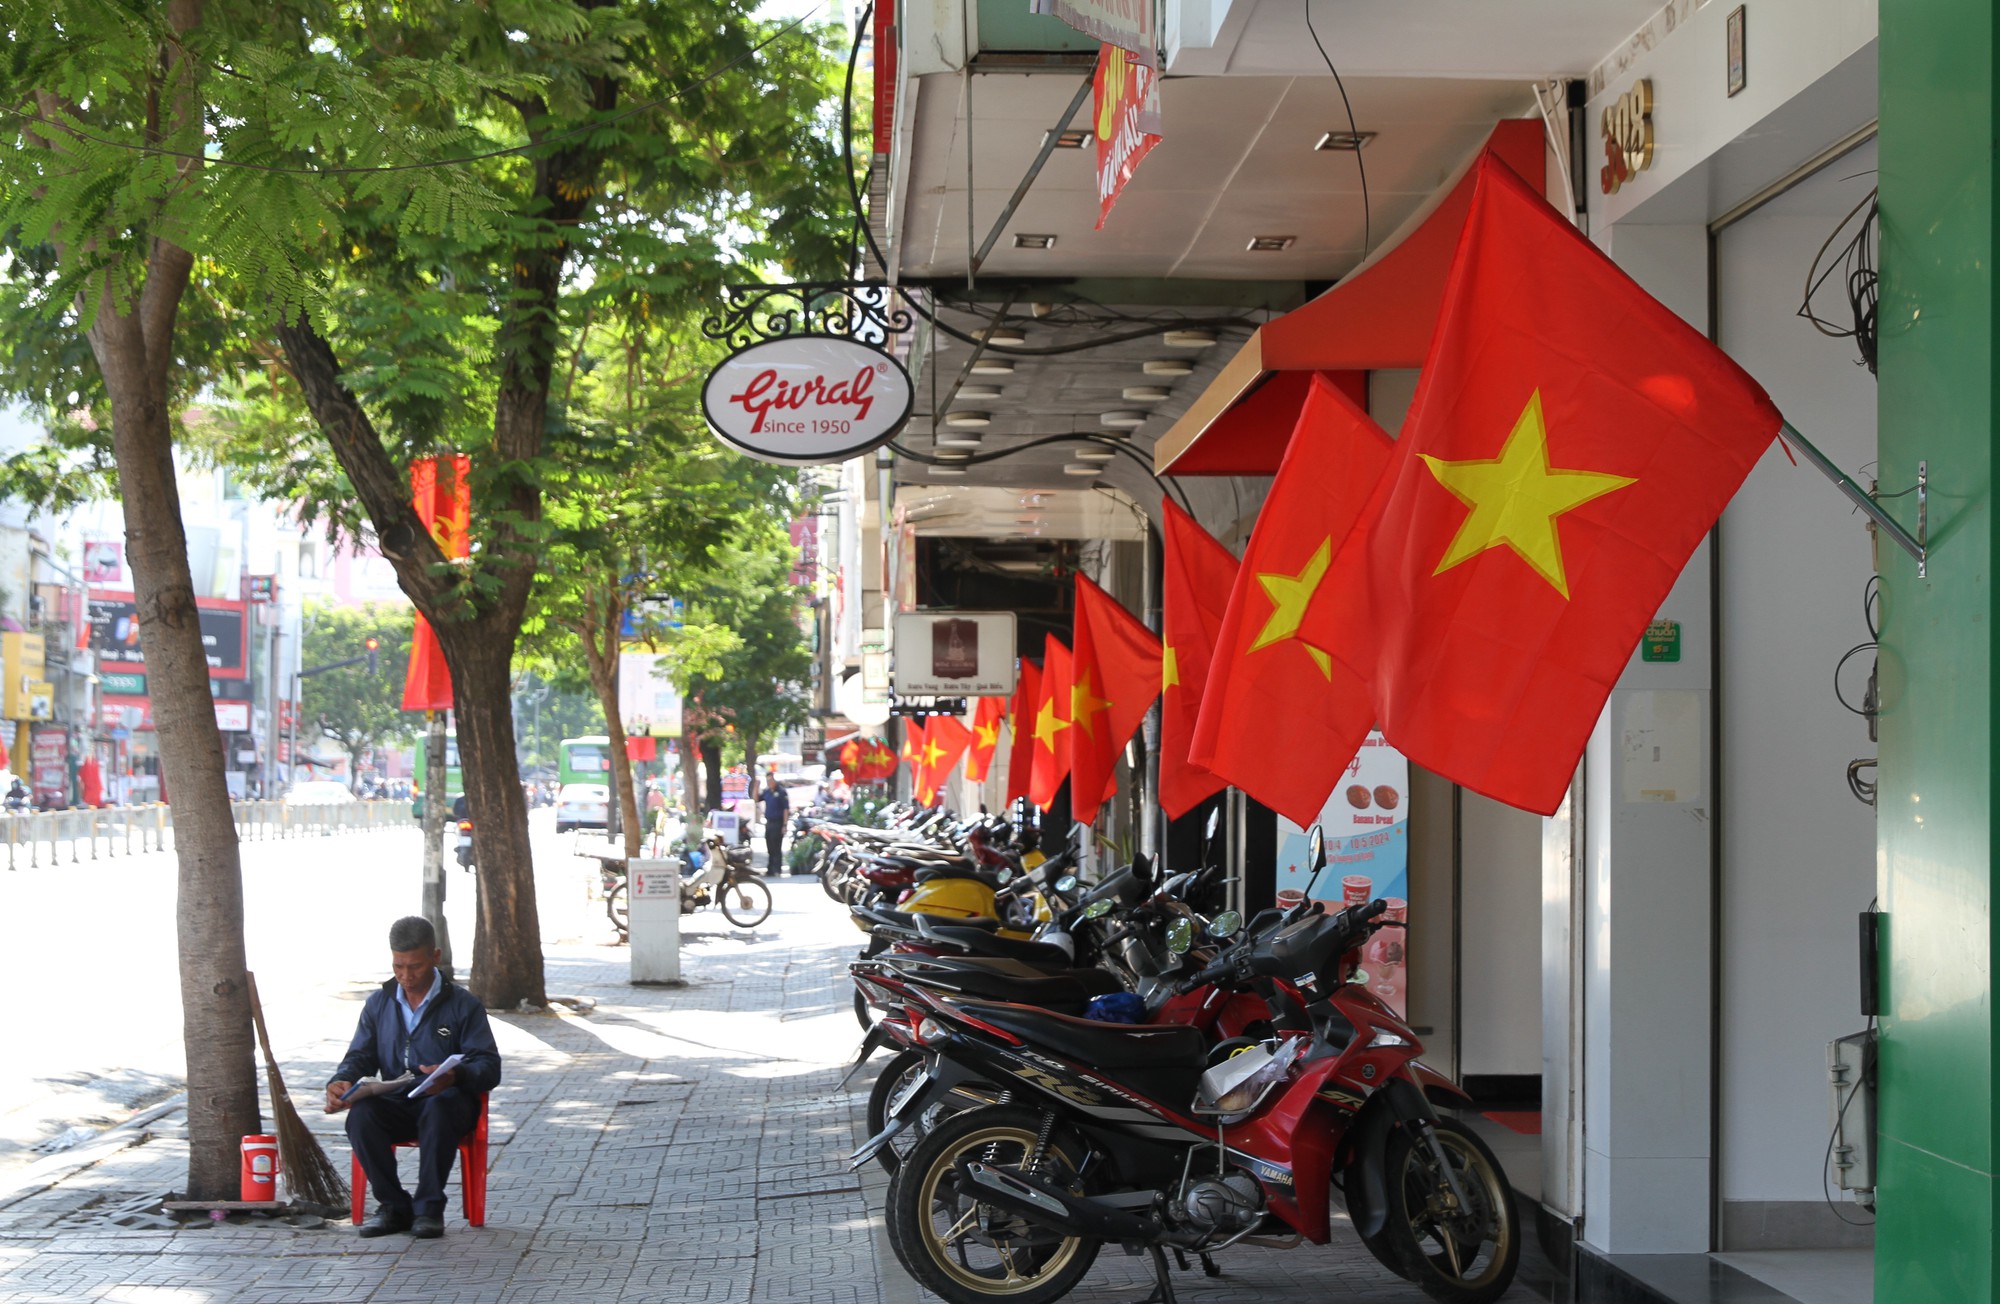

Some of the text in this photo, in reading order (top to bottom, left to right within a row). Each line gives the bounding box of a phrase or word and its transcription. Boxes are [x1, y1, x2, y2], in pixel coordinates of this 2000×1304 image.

[730, 365, 875, 434] Givral
[764, 420, 850, 434] since 1950
[1353, 815, 1394, 825] Banana Bread
[1260, 1165, 1293, 1186] YAMAHA
